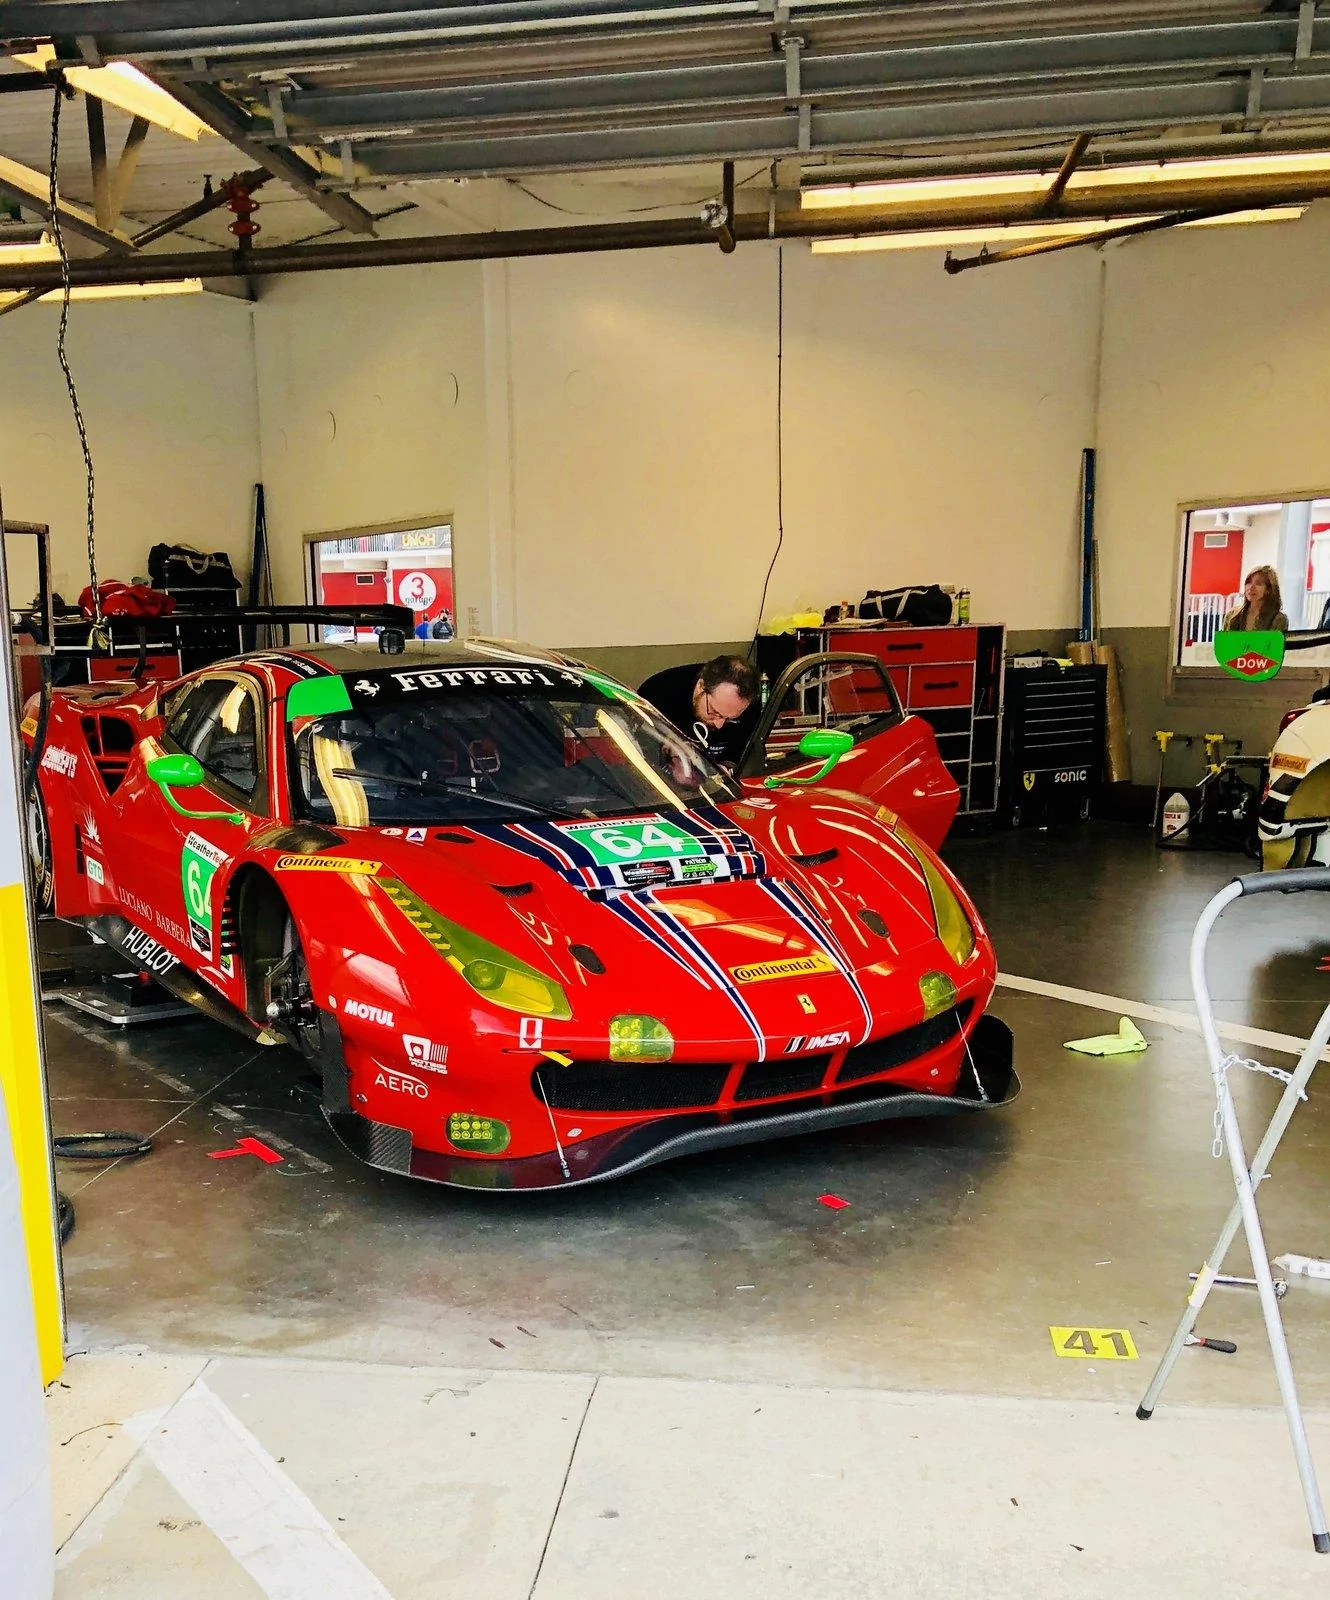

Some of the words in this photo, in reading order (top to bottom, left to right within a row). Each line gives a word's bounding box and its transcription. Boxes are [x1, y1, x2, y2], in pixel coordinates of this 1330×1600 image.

[405, 596, 433, 605] garage
[411, 577, 424, 599] 3
[391, 667, 554, 692] Ferrari
[589, 825, 684, 858] 64
[88, 860, 103, 880] GTD
[118, 886, 152, 921] LUCIANO
[156, 910, 192, 949] BARBERA
[121, 926, 181, 976] HUBLOT
[734, 958, 818, 981] Continental
[344, 999, 395, 1027] MOTUL
[805, 1031, 850, 1050] IMSA
[374, 1073, 429, 1099] AERO
[1063, 1330, 1130, 1357] 41
